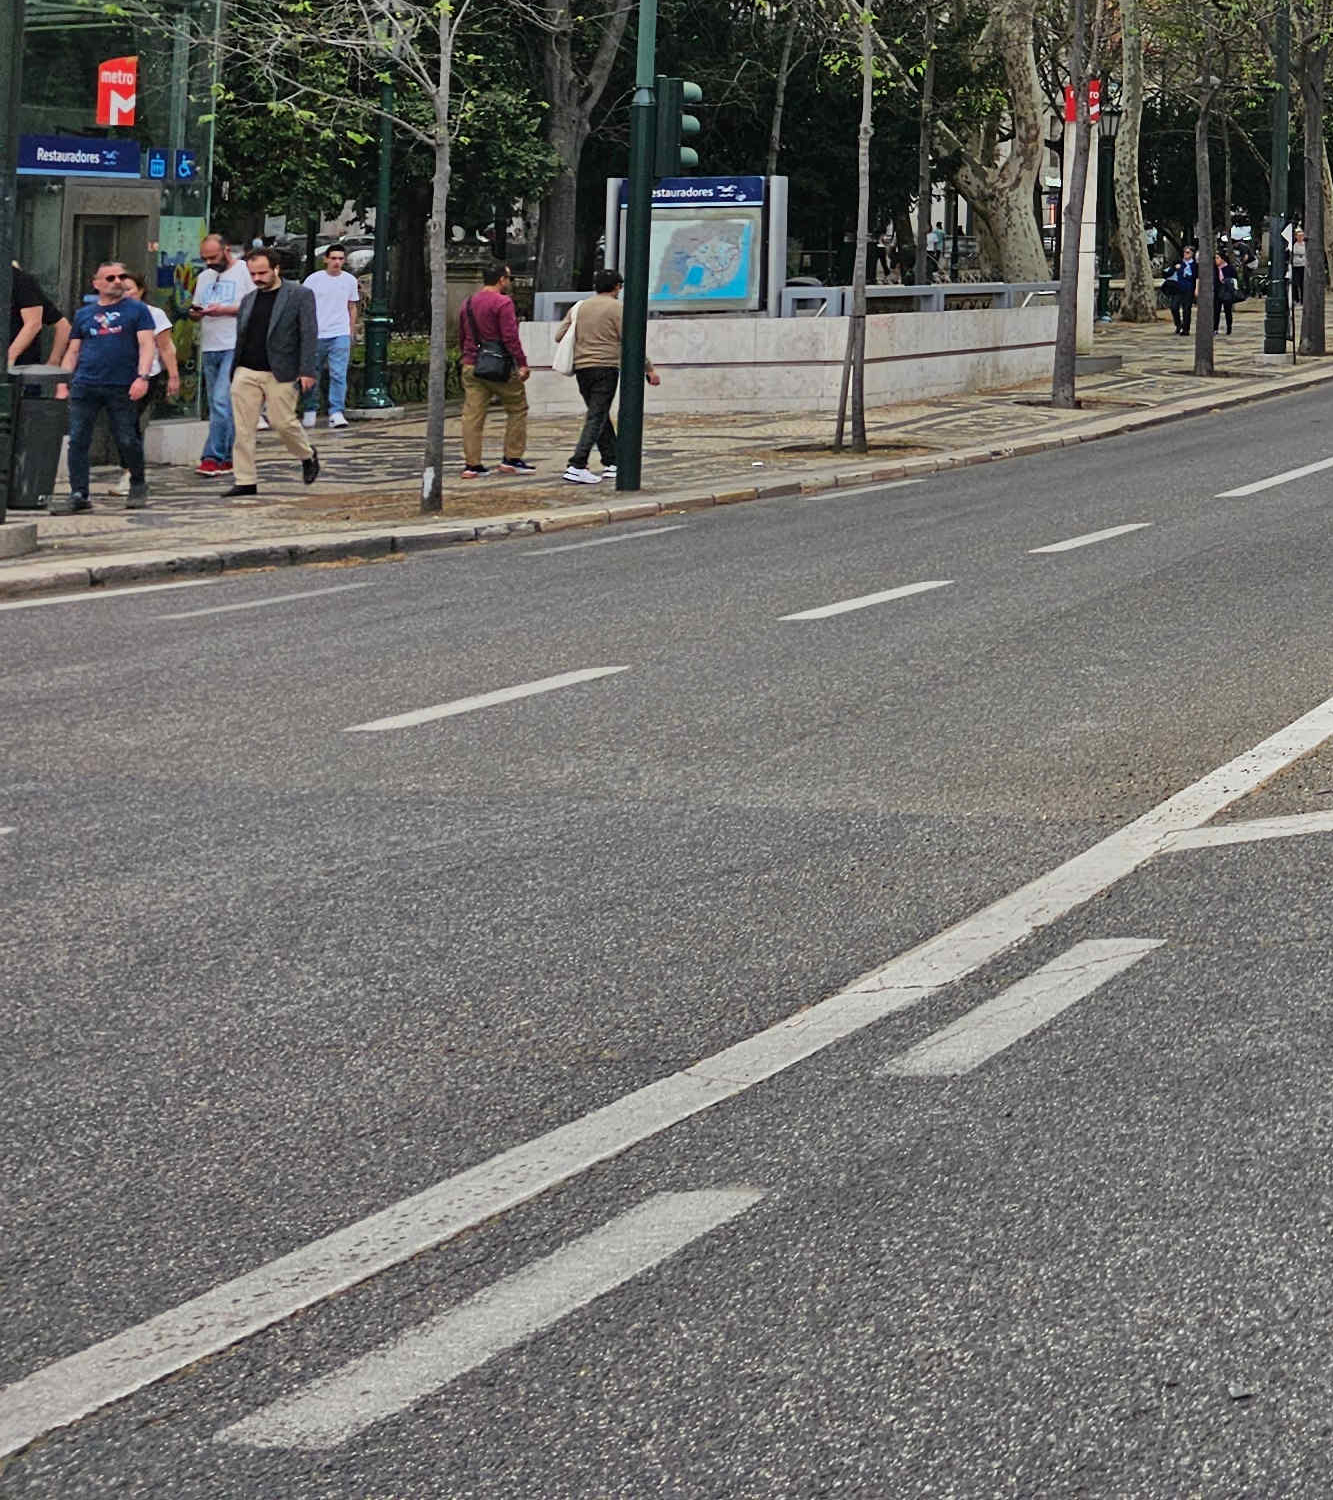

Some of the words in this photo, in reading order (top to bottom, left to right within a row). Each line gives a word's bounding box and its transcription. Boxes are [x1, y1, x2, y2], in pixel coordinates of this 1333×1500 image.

[101, 70, 134, 85] metro
[36, 147, 100, 164] Restauradores
[652, 186, 714, 198] estauradores
